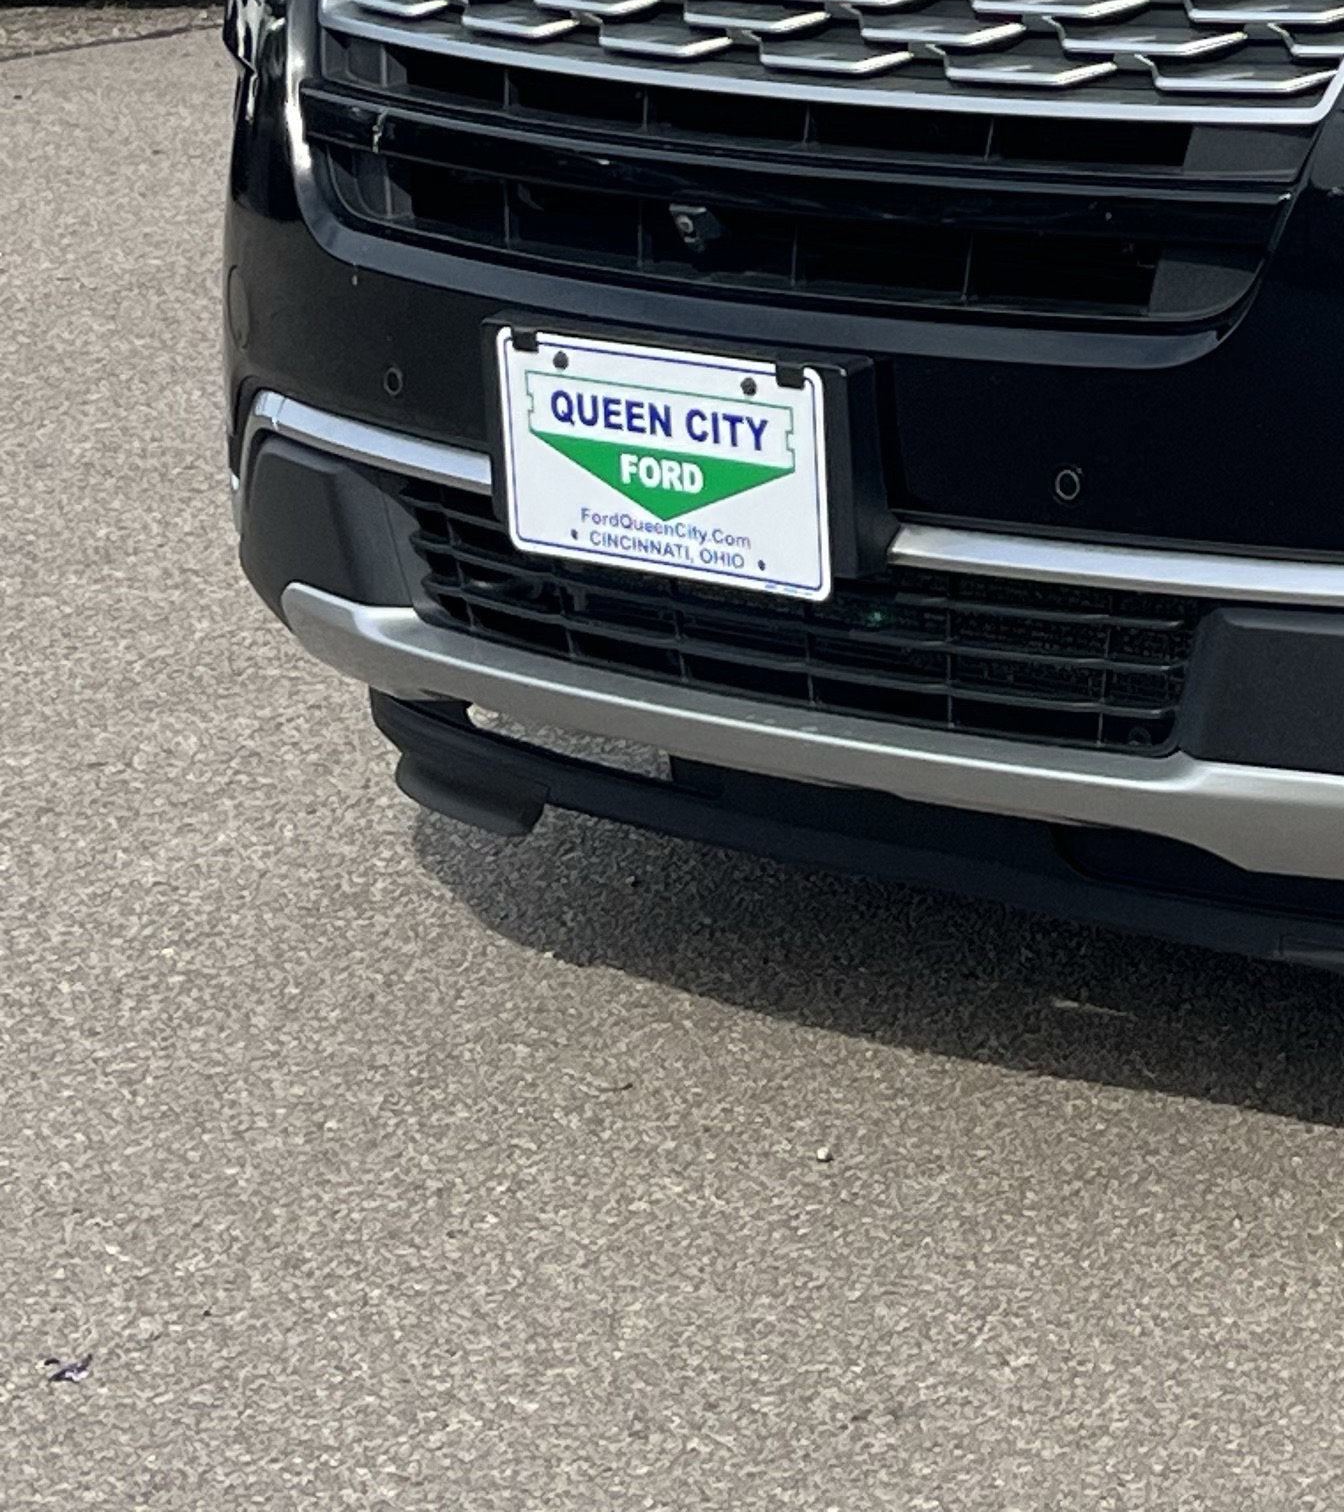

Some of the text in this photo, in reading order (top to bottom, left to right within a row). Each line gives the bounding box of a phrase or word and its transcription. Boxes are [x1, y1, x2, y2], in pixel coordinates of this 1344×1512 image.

[550, 390, 769, 451] QUEEN CITY
[619, 453, 704, 494] FORD
[580, 507, 752, 550] FordQueenCity.Com
[589, 530, 745, 570] CINCINNATI, OHIO
